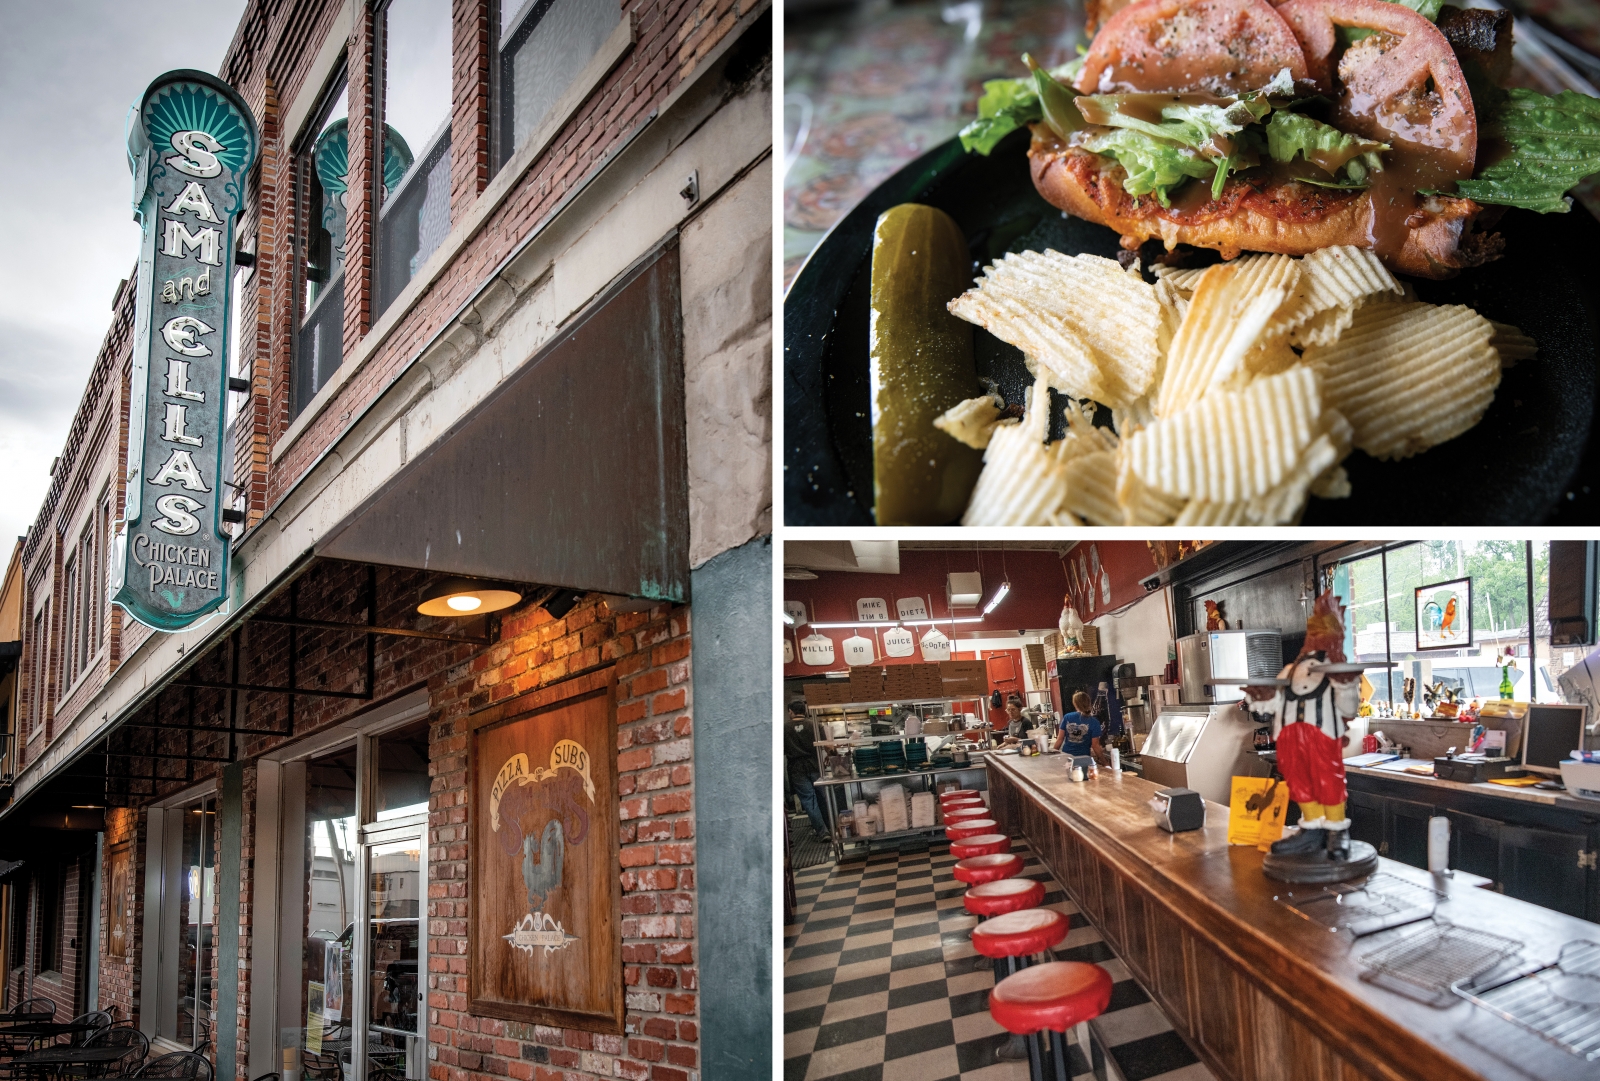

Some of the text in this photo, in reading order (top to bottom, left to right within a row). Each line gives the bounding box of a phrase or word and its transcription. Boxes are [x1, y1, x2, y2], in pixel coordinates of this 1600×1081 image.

[159, 130, 228, 267] SAM
[160, 266, 211, 303] and
[147, 316, 217, 536] ELLAS
[132, 533, 211, 568] CHICKEN
[146, 562, 219, 592] PALACE
[900, 608, 925, 617] DIETZ
[802, 645, 834, 653] WILLIE
[886, 638, 911, 646] JUICE
[921, 641, 951, 650] SCOOTER
[492, 758, 523, 802] PIZZA
[554, 744, 587, 771] SUBS
[518, 934, 561, 942] CHICKEN PALACE
